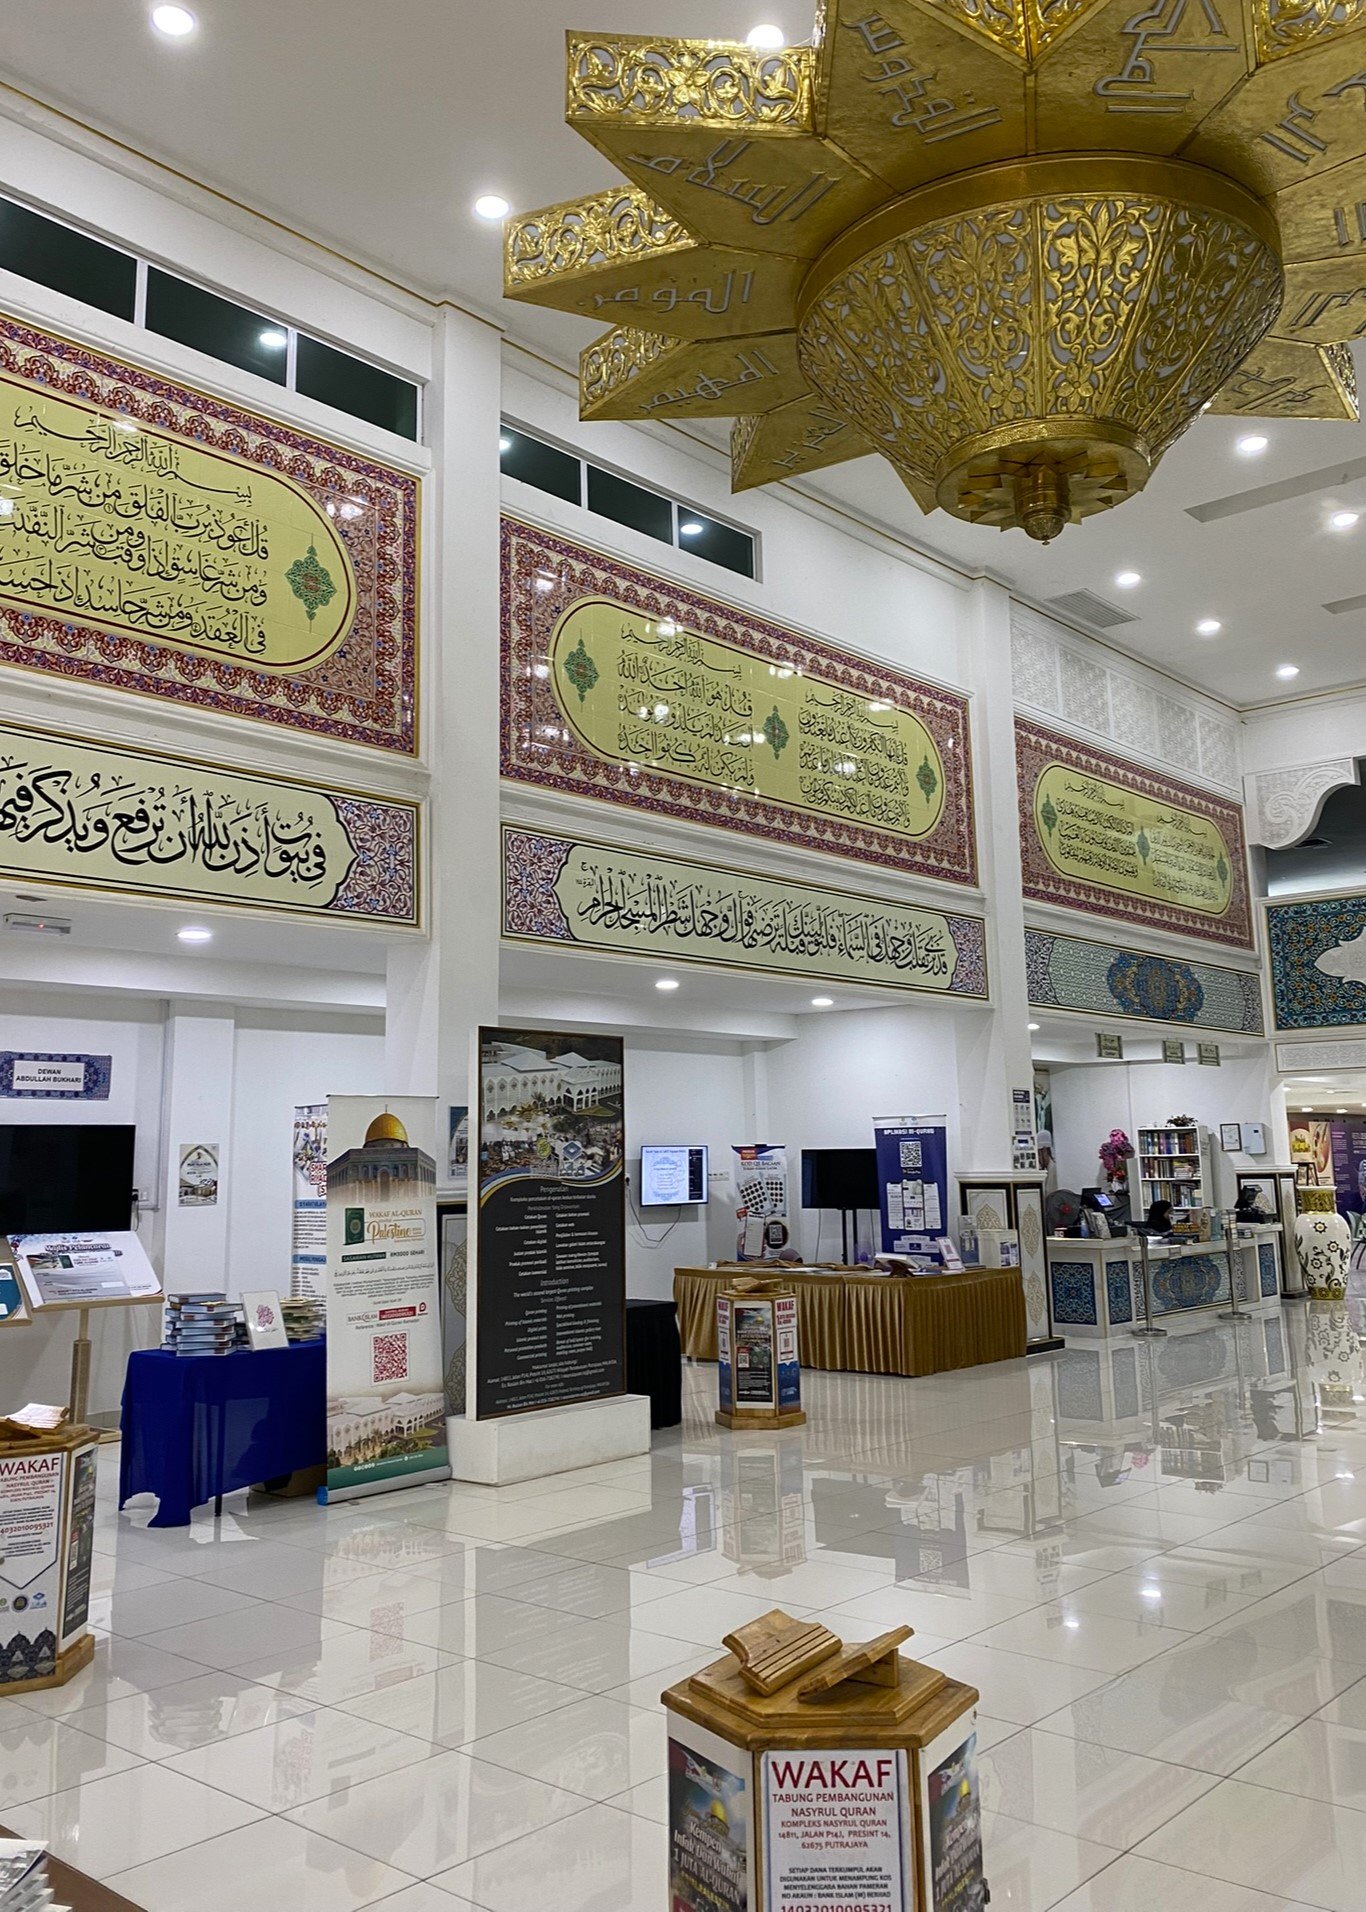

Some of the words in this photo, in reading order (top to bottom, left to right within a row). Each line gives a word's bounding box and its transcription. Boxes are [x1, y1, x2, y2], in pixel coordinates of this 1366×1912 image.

[16, 1075, 51, 1083] ABDULLAH
[0, 1457, 60, 1477] WAKAF
[771, 1760, 893, 1789] WAKAF
[772, 1793, 814, 1803] TABUNG
[816, 1791, 895, 1803] PEMBANGUNAN
[791, 1807, 838, 1817] NASYRUL
[840, 1806, 877, 1819] QURAN
[781, 1820, 822, 1829] KOMPLEKS
[823, 1819, 858, 1828] NASYRUL
[859, 1818, 888, 1829] QURAN
[801, 1831, 824, 1839] JALAN
[848, 1829, 879, 1838] PRESINT
[801, 1841, 823, 1850] 62675
[824, 1841, 869, 1849] PUTRAJAYA
[788, 1866, 809, 1874] SETIAP
[810, 1866, 828, 1874] DANA
[828, 1866, 865, 1874] TERKUMPUL
